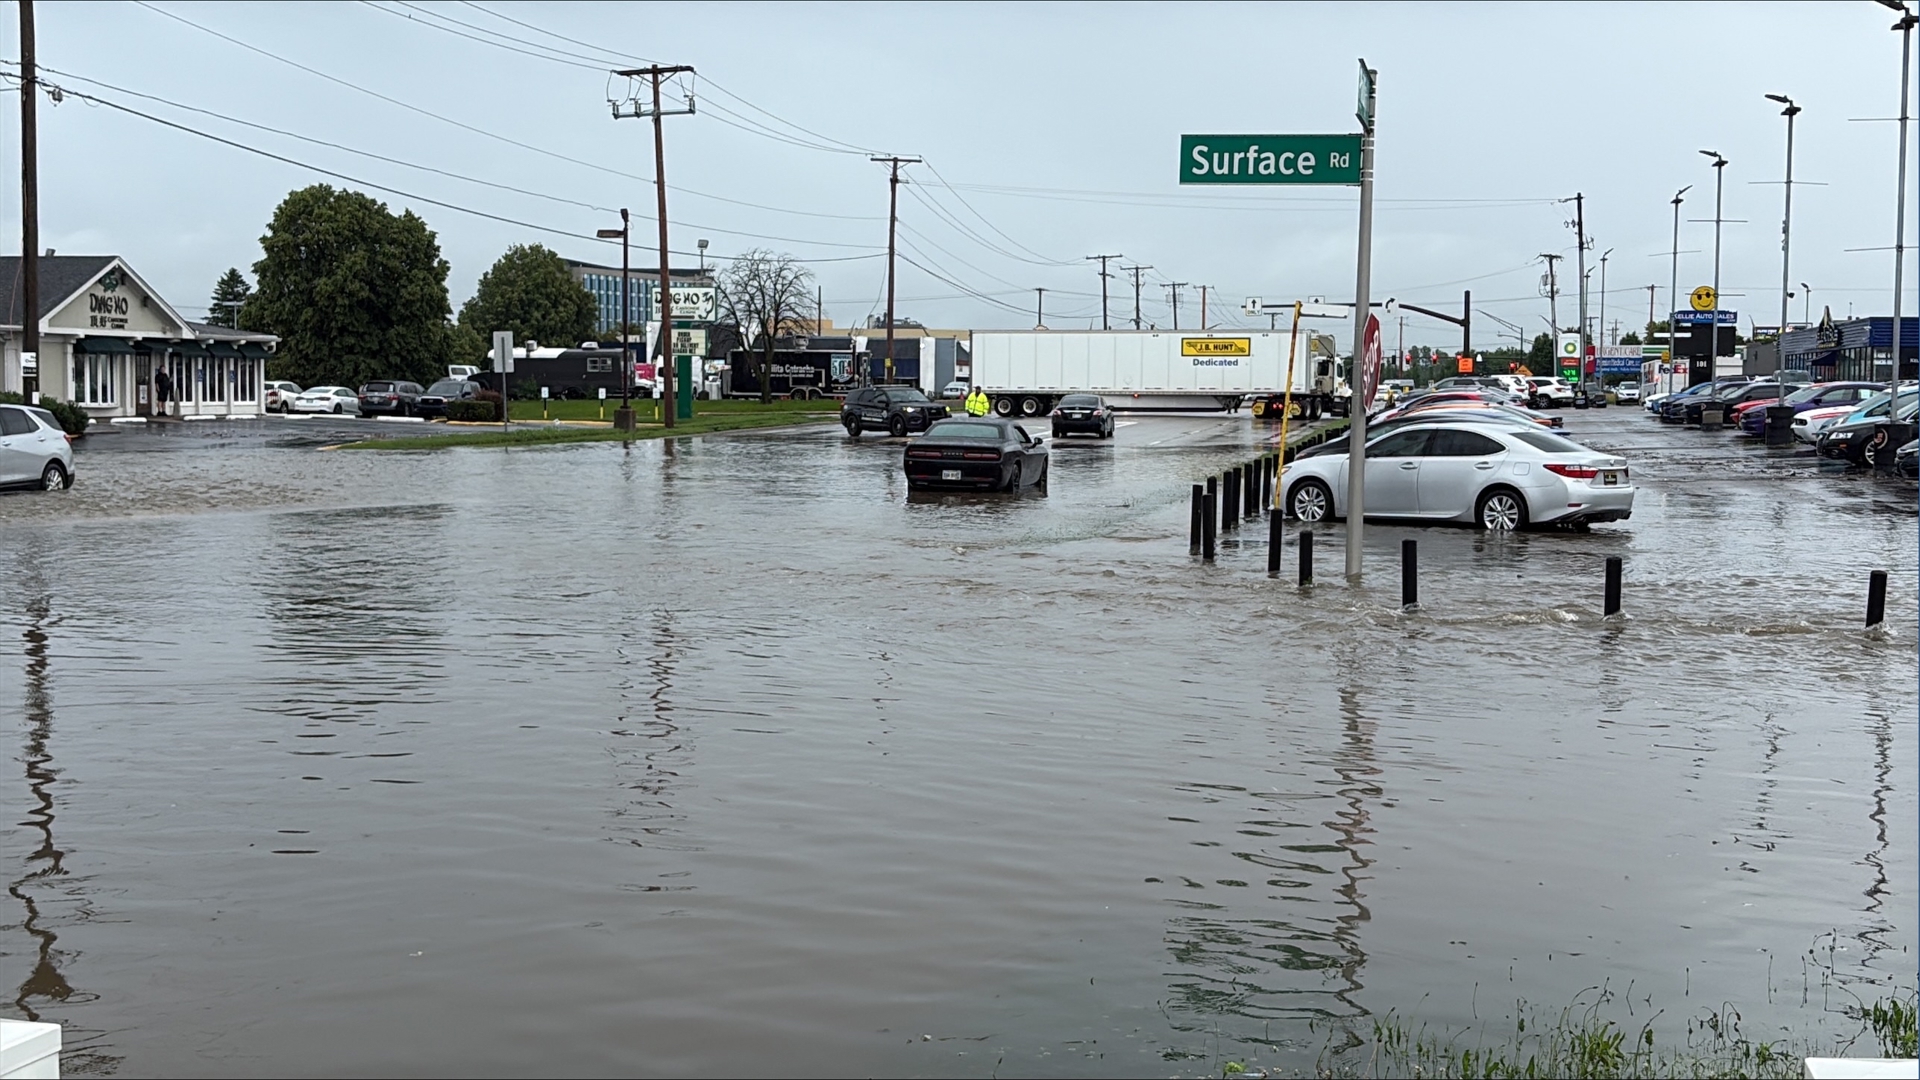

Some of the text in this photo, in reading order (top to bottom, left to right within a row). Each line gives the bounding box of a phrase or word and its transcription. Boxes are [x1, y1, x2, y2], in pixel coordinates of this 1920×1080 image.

[1191, 145, 1350, 175] Surface Rd
[1197, 343, 1234, 352] J.B. HUNT
[1192, 358, 1239, 366] Dedicated
[1363, 329, 1379, 396] STOP
